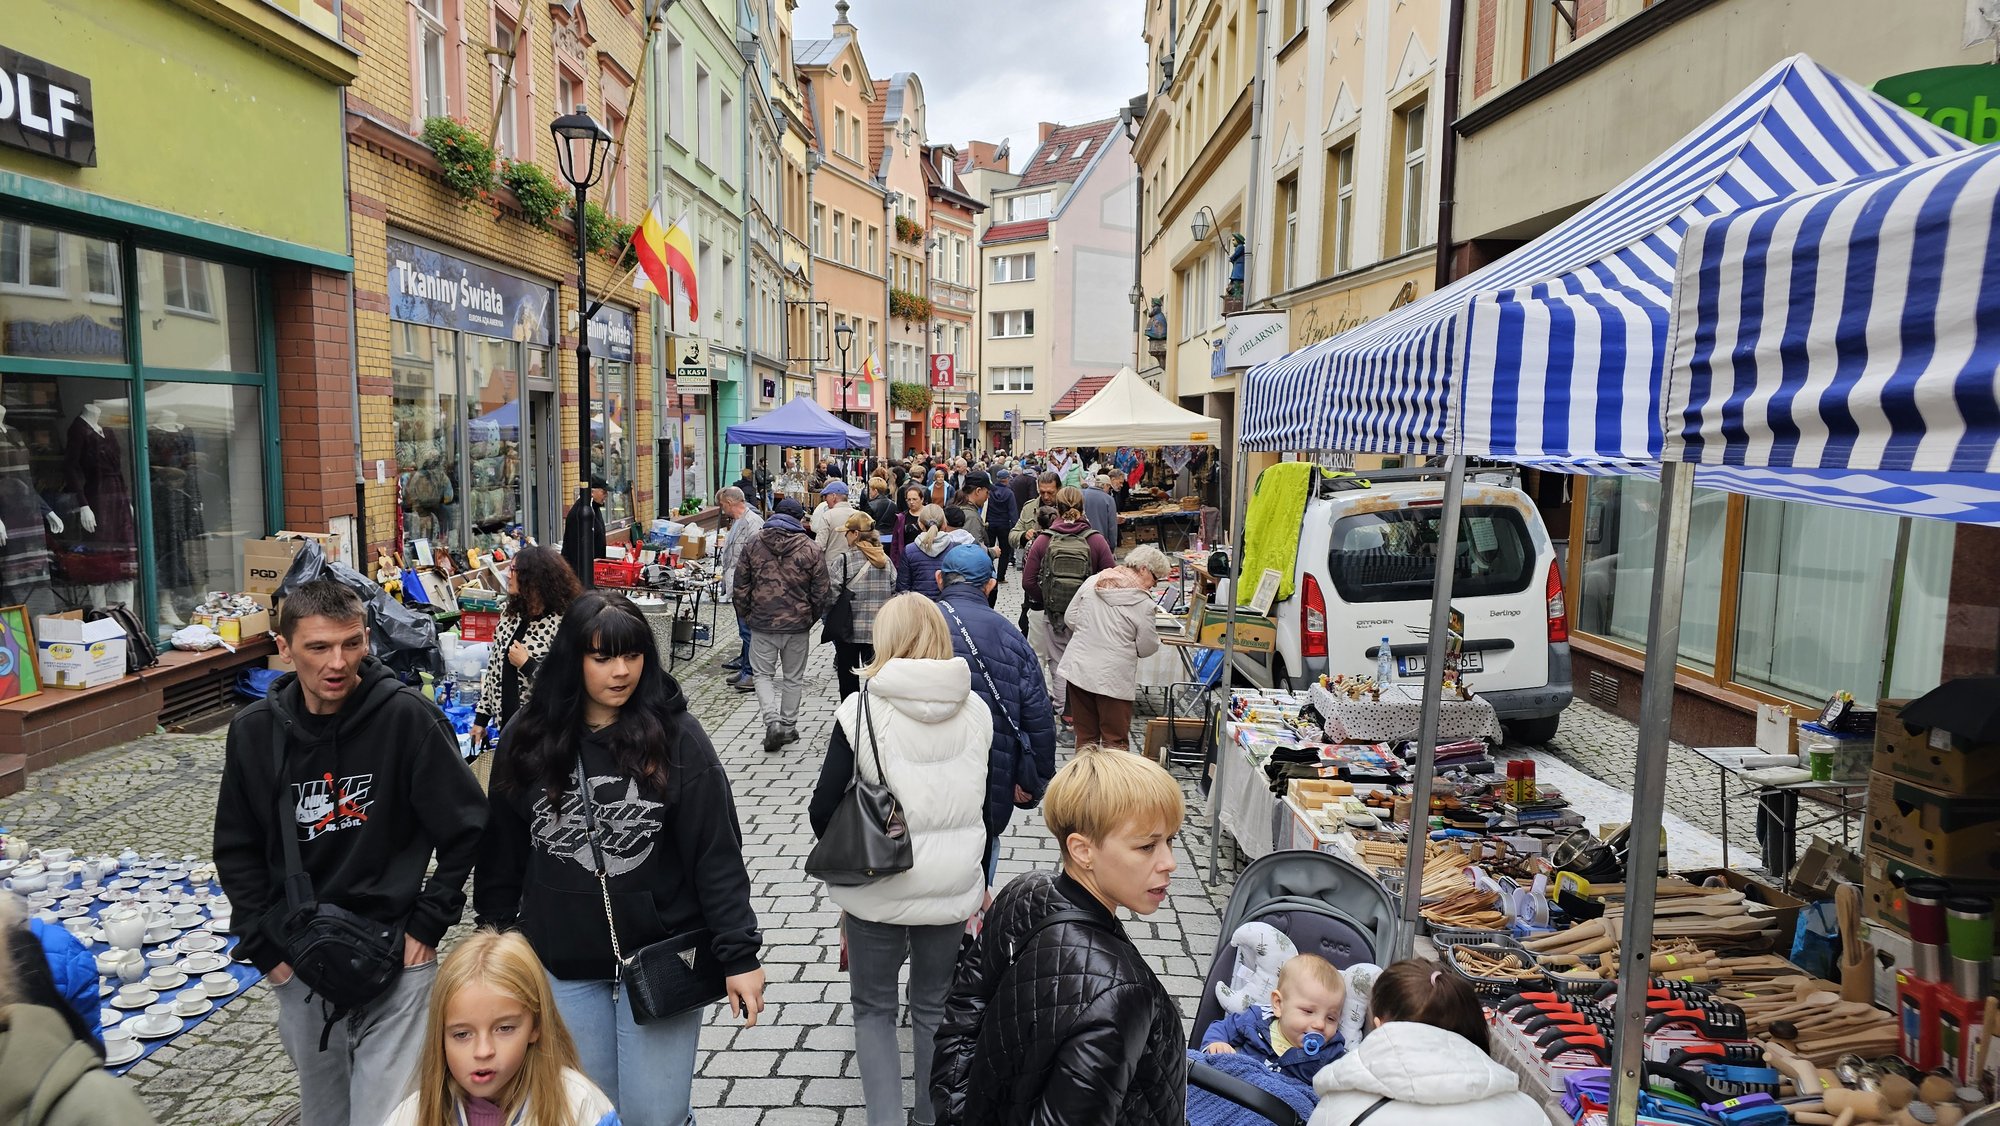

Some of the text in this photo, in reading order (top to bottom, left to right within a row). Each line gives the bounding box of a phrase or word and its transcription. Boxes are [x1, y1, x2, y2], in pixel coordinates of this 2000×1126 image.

[396, 260, 504, 315] Tkaniny Świata
[587, 314, 631, 346] aniny Świata
[1239, 322, 1283, 356] ZIELARNIA
[250, 568, 278, 579] PGD
[1489, 609, 1522, 617] Berlingo
[960, 626, 978, 656] Reebok
[1460, 652, 1478, 668] 6E
[983, 671, 1000, 700] Reebok
[304, 794, 330, 809] NIKE
